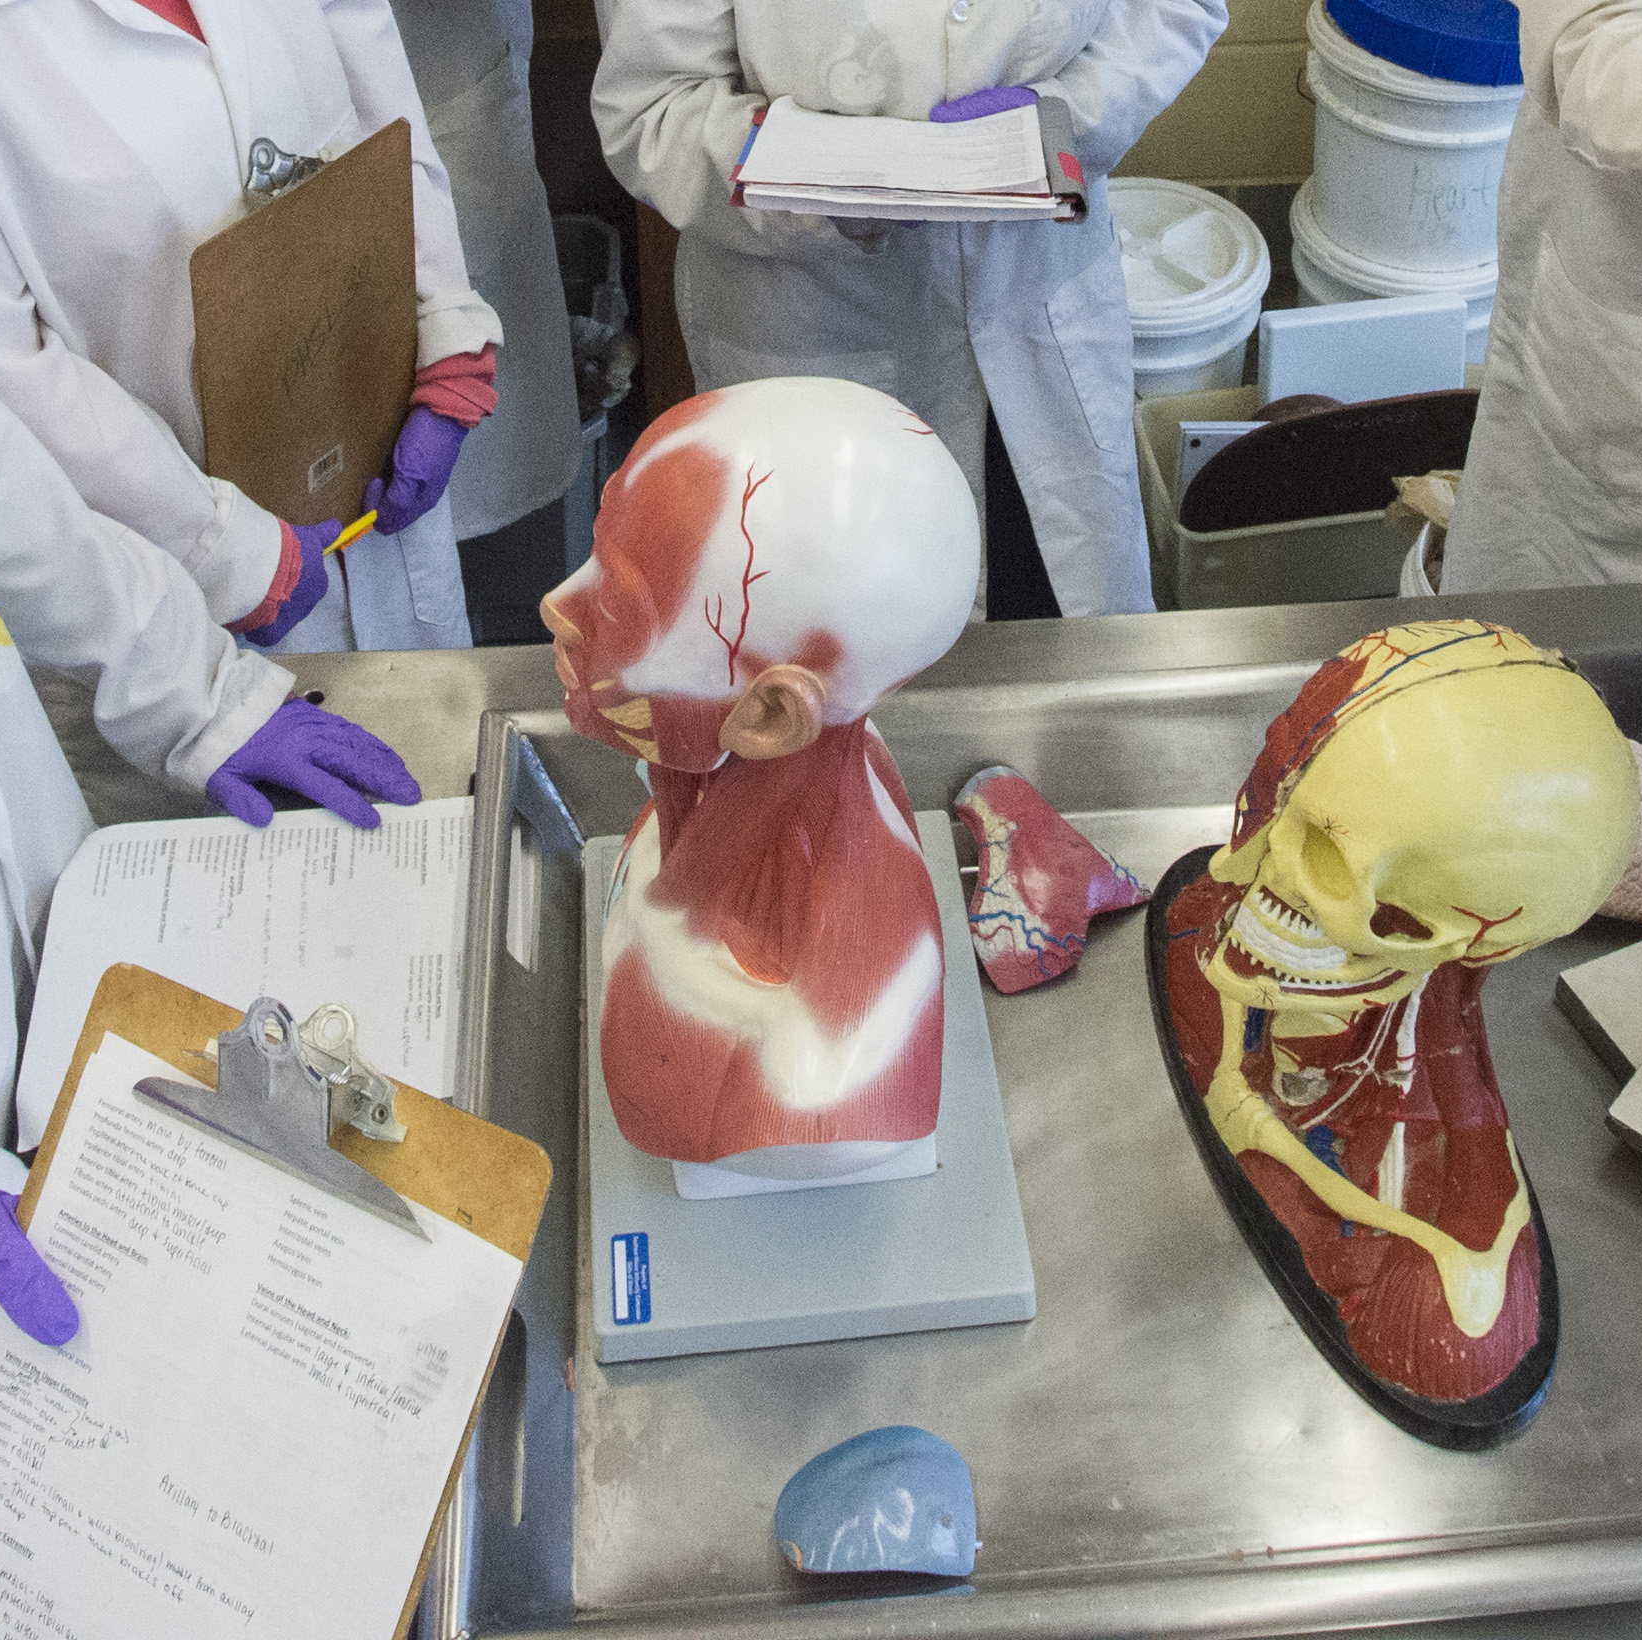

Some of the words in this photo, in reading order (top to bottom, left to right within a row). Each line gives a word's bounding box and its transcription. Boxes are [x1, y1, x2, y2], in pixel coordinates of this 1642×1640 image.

[92, 1110, 122, 1131] Profunda
[146, 1140, 165, 1154] artery
[94, 1179, 113, 1195] artery
[126, 1163, 146, 1178] artery
[58, 1208, 82, 1229] Arteries
[100, 1233, 118, 1247] Head
[108, 1204, 127, 1219] artery
[282, 1209, 308, 1228] Hepatic
[307, 1223, 331, 1238] portal
[329, 1234, 345, 1246] vein
[47, 1236, 74, 1255] External
[72, 1251, 95, 1268] carotid
[93, 1263, 112, 1279] artery
[52, 1222, 81, 1242] Common
[80, 1238, 103, 1255] carotid
[100, 1250, 120, 1266] artery
[272, 1238, 295, 1256] Azygos
[295, 1250, 311, 1264] Vein
[277, 1224, 314, 1247] Intercostal
[313, 1244, 331, 1258] veins
[87, 1277, 106, 1293] artery
[266, 1253, 306, 1280] Hemiazygos
[306, 1274, 323, 1288] Vein
[256, 1283, 275, 1299] Veins
[296, 1304, 316, 1321] Head
[330, 1321, 347, 1336] Neck:
[239, 1326, 268, 1347] External
[266, 1343, 291, 1360] jugular
[291, 1357, 307, 1369] vein
[245, 1312, 272, 1331] Internal
[270, 1327, 296, 1344] jugular
[295, 1340, 311, 1353] vein
[249, 1296, 270, 1313] Dural
[269, 1308, 294, 1327] sinuses
[293, 1319, 324, 1340] (sagittal
[336, 1343, 375, 1371] transverse)
[4, 1349, 22, 1367] Veins
[39, 1371, 60, 1388] Upper
[9, 1408, 31, 1424] cubital
[31, 1421, 45, 1433] vein
